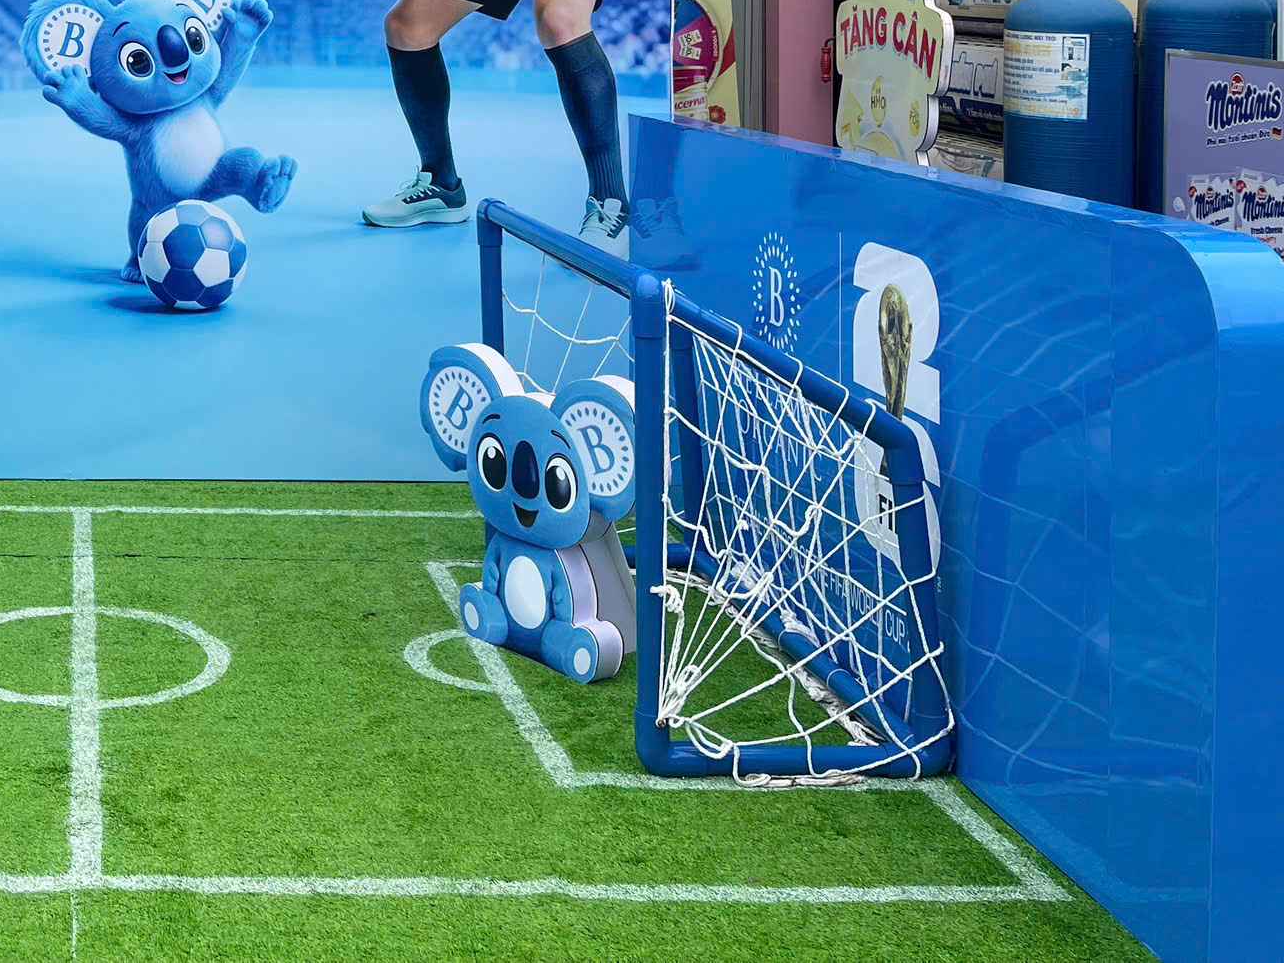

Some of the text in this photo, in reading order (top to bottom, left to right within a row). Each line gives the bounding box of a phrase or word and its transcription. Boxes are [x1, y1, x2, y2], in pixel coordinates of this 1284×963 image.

[57, 21, 85, 58] B
[840, 5, 937, 79] TĂNG CÂN
[1206, 83, 1282, 131] Montinis
[1195, 189, 1234, 220] Montinis
[769, 267, 784, 327] B
[445, 388, 473, 429] B
[577, 425, 615, 474] B
[885, 609, 906, 646] CUP
